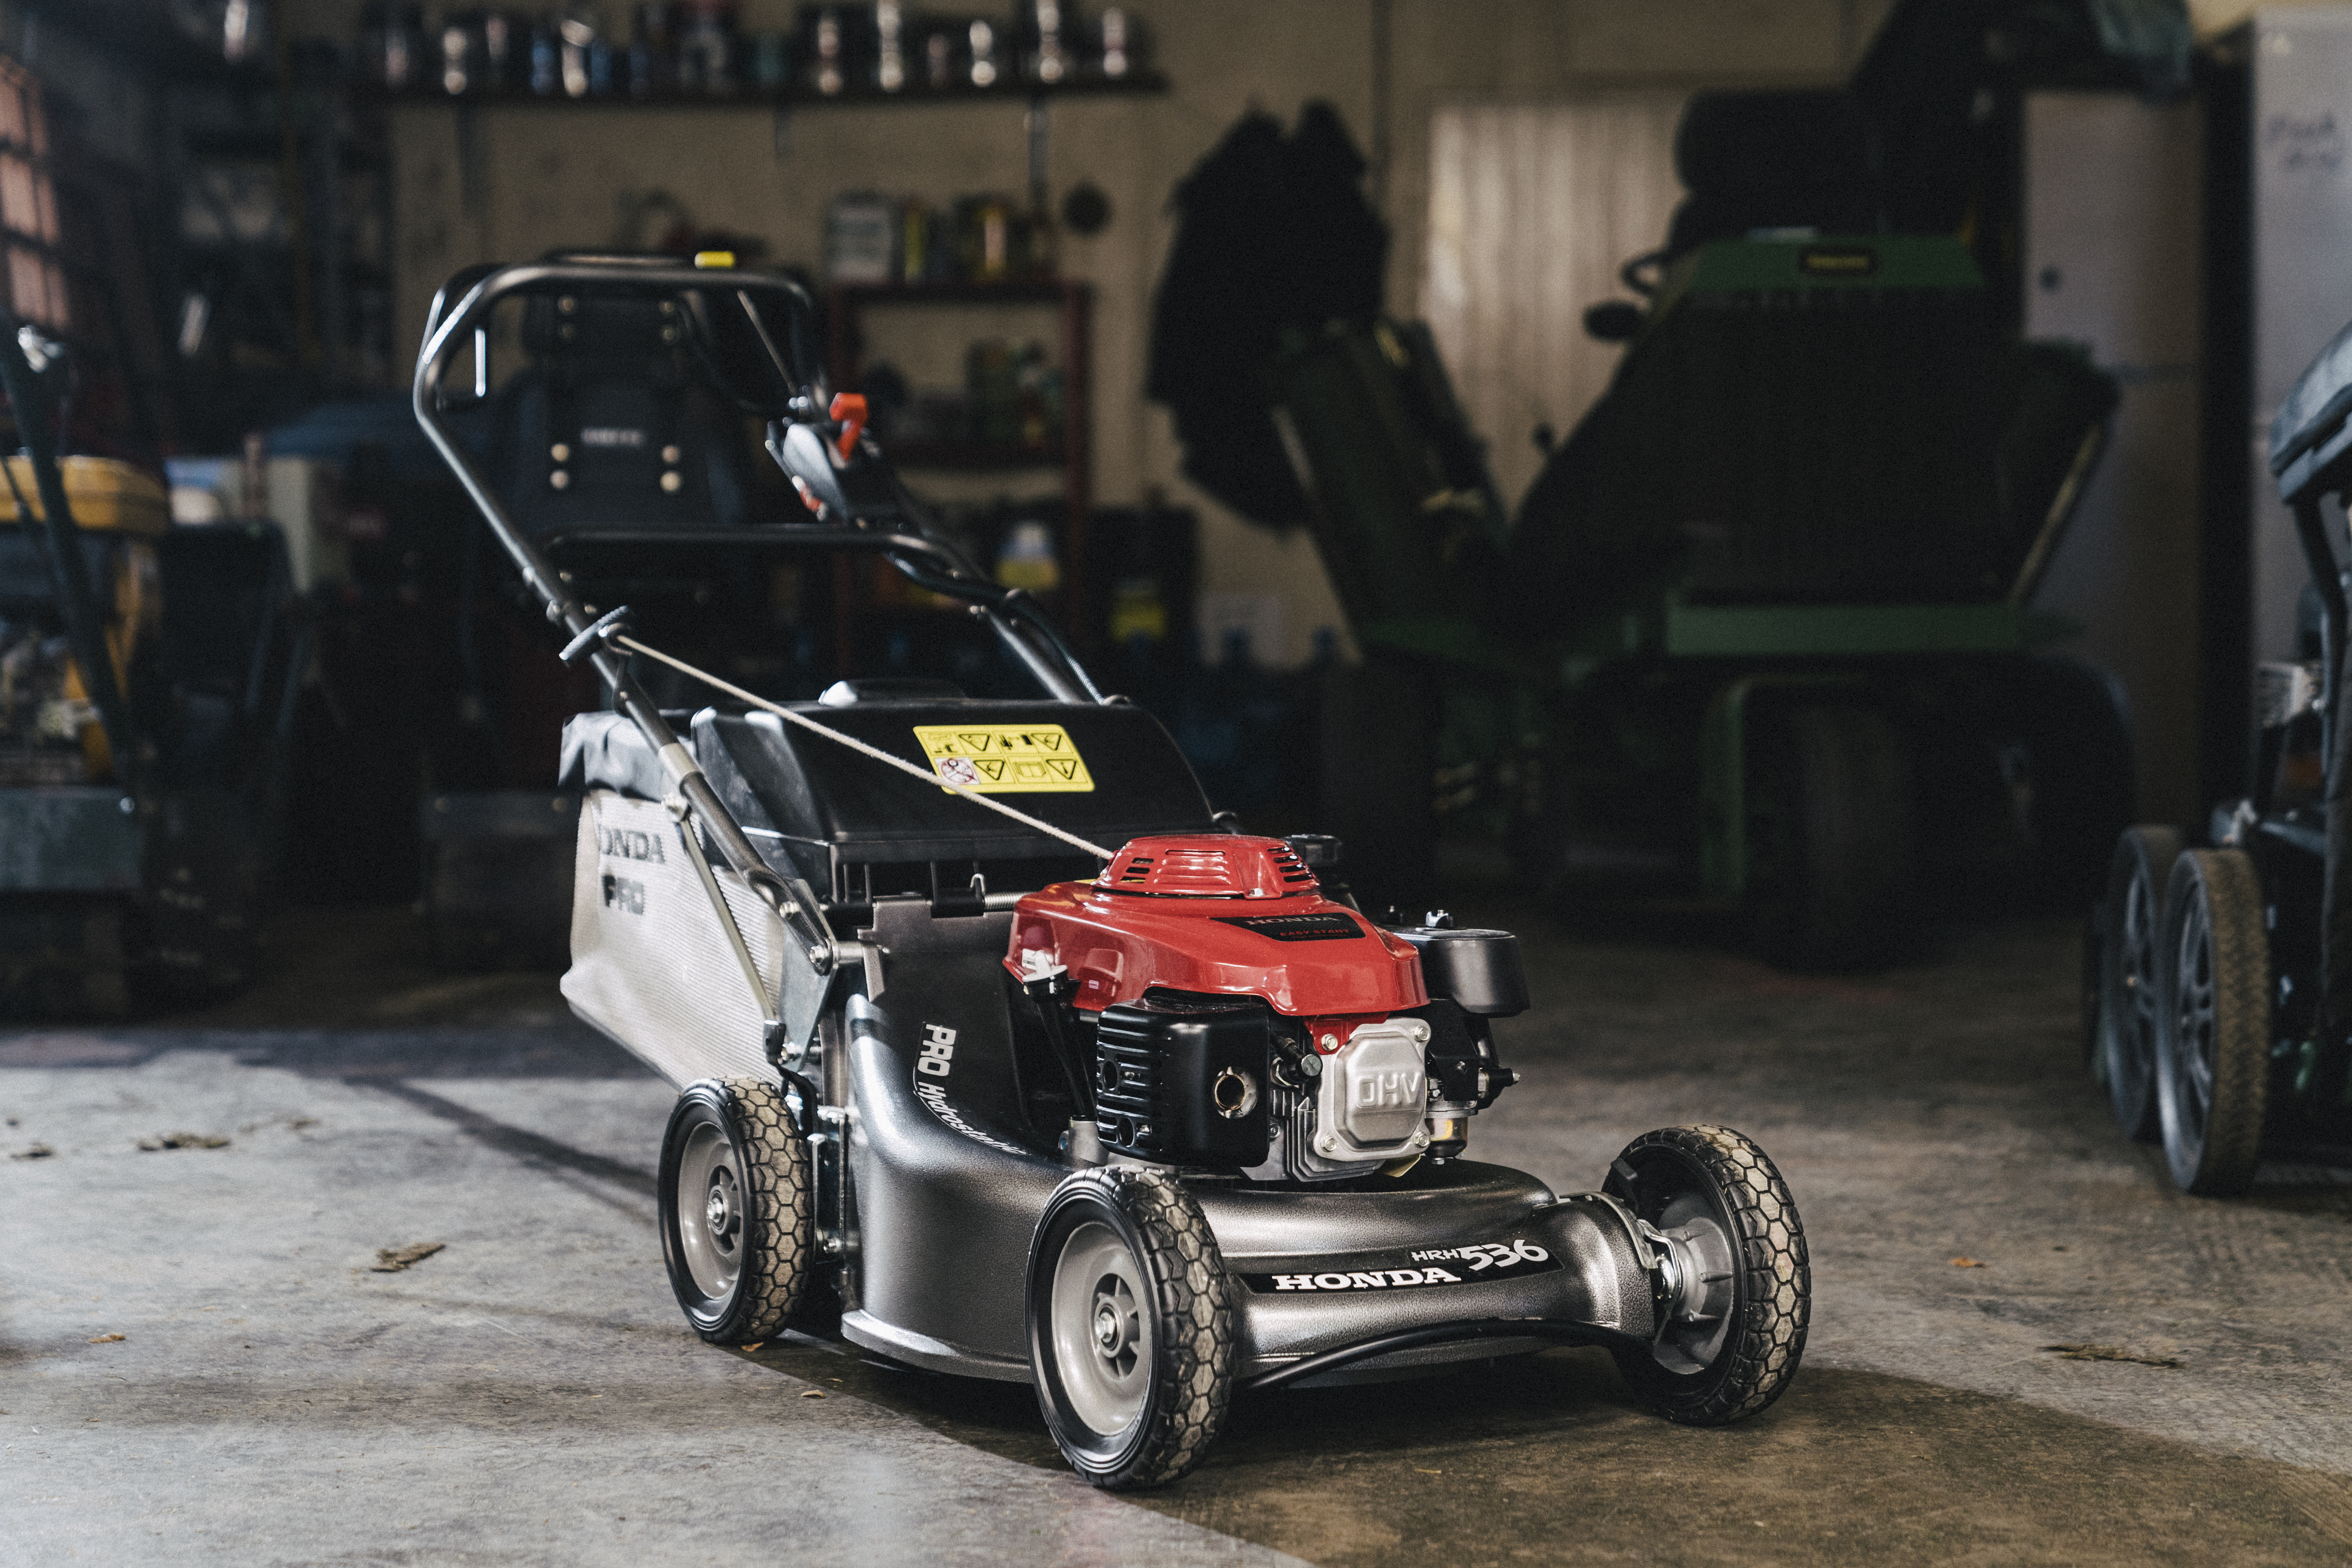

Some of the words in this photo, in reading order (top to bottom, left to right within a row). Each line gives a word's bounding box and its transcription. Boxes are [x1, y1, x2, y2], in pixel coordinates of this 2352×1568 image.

[598, 824, 666, 864] ONDA
[601, 873, 644, 915] PRO
[1244, 917, 1341, 925] HONDA
[918, 1024, 956, 1076] PRO
[1357, 1072, 1421, 1107] OHV
[1272, 1267, 1461, 1290] HONDA
